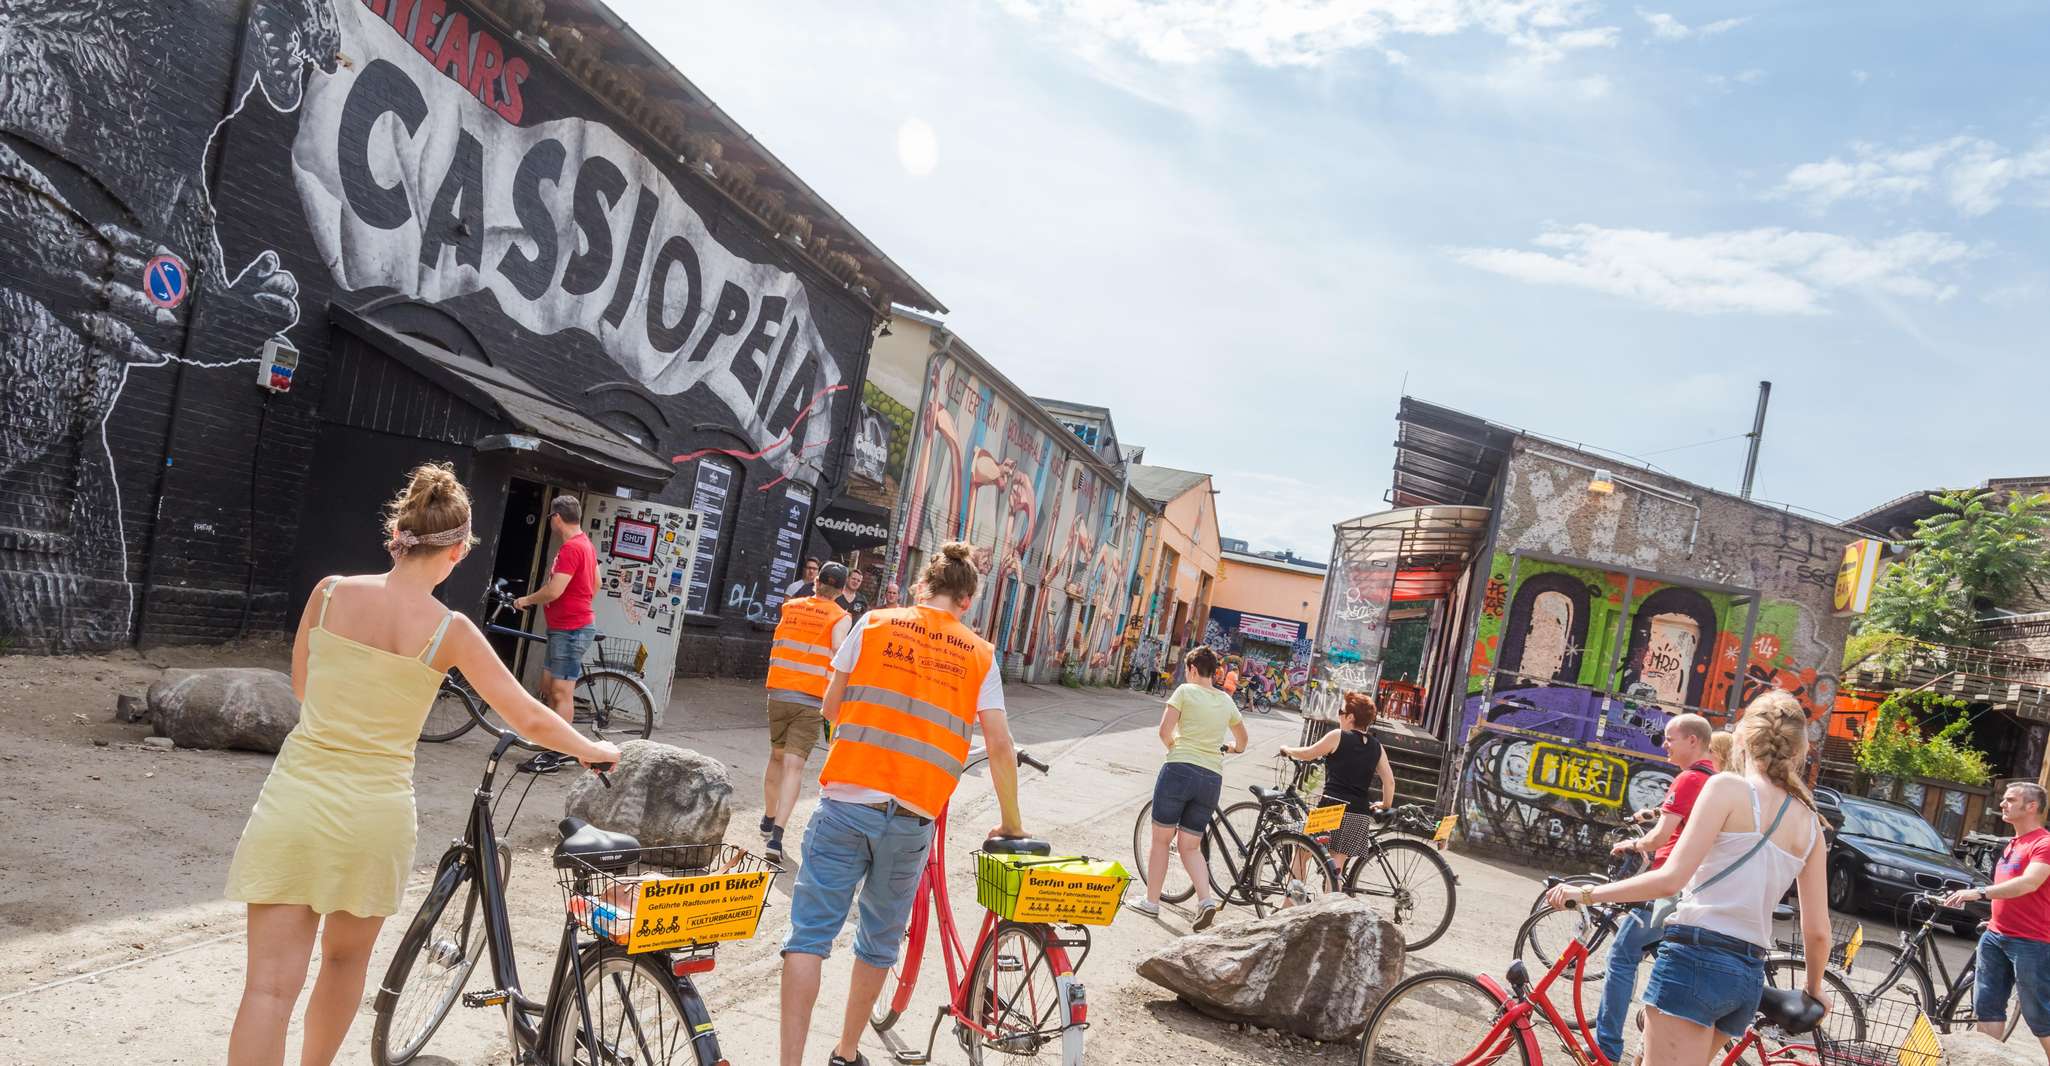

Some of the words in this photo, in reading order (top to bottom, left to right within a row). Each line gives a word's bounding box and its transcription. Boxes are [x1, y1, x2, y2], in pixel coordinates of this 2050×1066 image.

[338, 59, 820, 455] CASSIOPEIA
[815, 515, 888, 538] cassiopeia
[624, 534, 645, 544] SHUT
[891, 618, 925, 634] Berlin
[929, 632, 943, 640] on
[947, 635, 975, 652] Bike!
[645, 883, 694, 898] Berlin
[700, 880, 720, 893] on
[726, 878, 763, 890] Bike!
[1029, 878, 1064, 888] Berlin
[1087, 883, 1115, 891] Bike!
[648, 902, 681, 911] Geführte
[682, 898, 720, 907] Radtouren
[730, 895, 754, 903] Verleih
[691, 910, 753, 926] KULTURBRAUEREI
